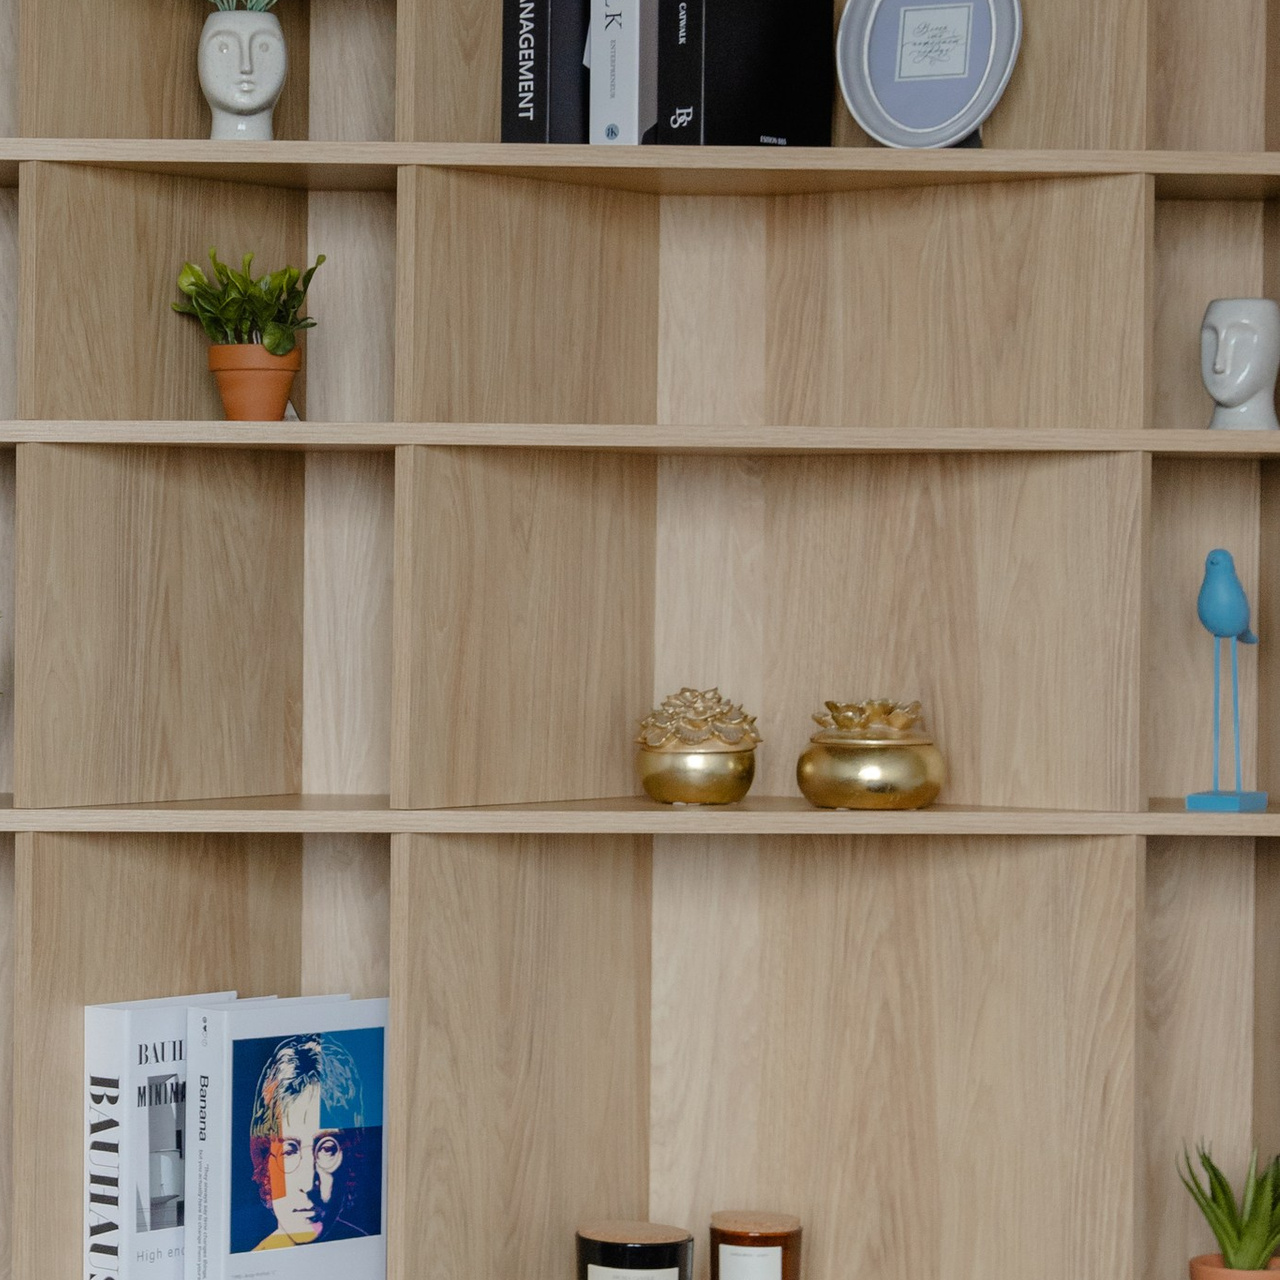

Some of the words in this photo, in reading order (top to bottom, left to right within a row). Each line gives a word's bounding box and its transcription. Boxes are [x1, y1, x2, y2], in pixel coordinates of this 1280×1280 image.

[678, 2, 687, 45] CATWALK
[138, 1039, 186, 1065] BAUH
[199, 1075, 210, 1141] Banana
[137, 1248, 162, 1263] High
